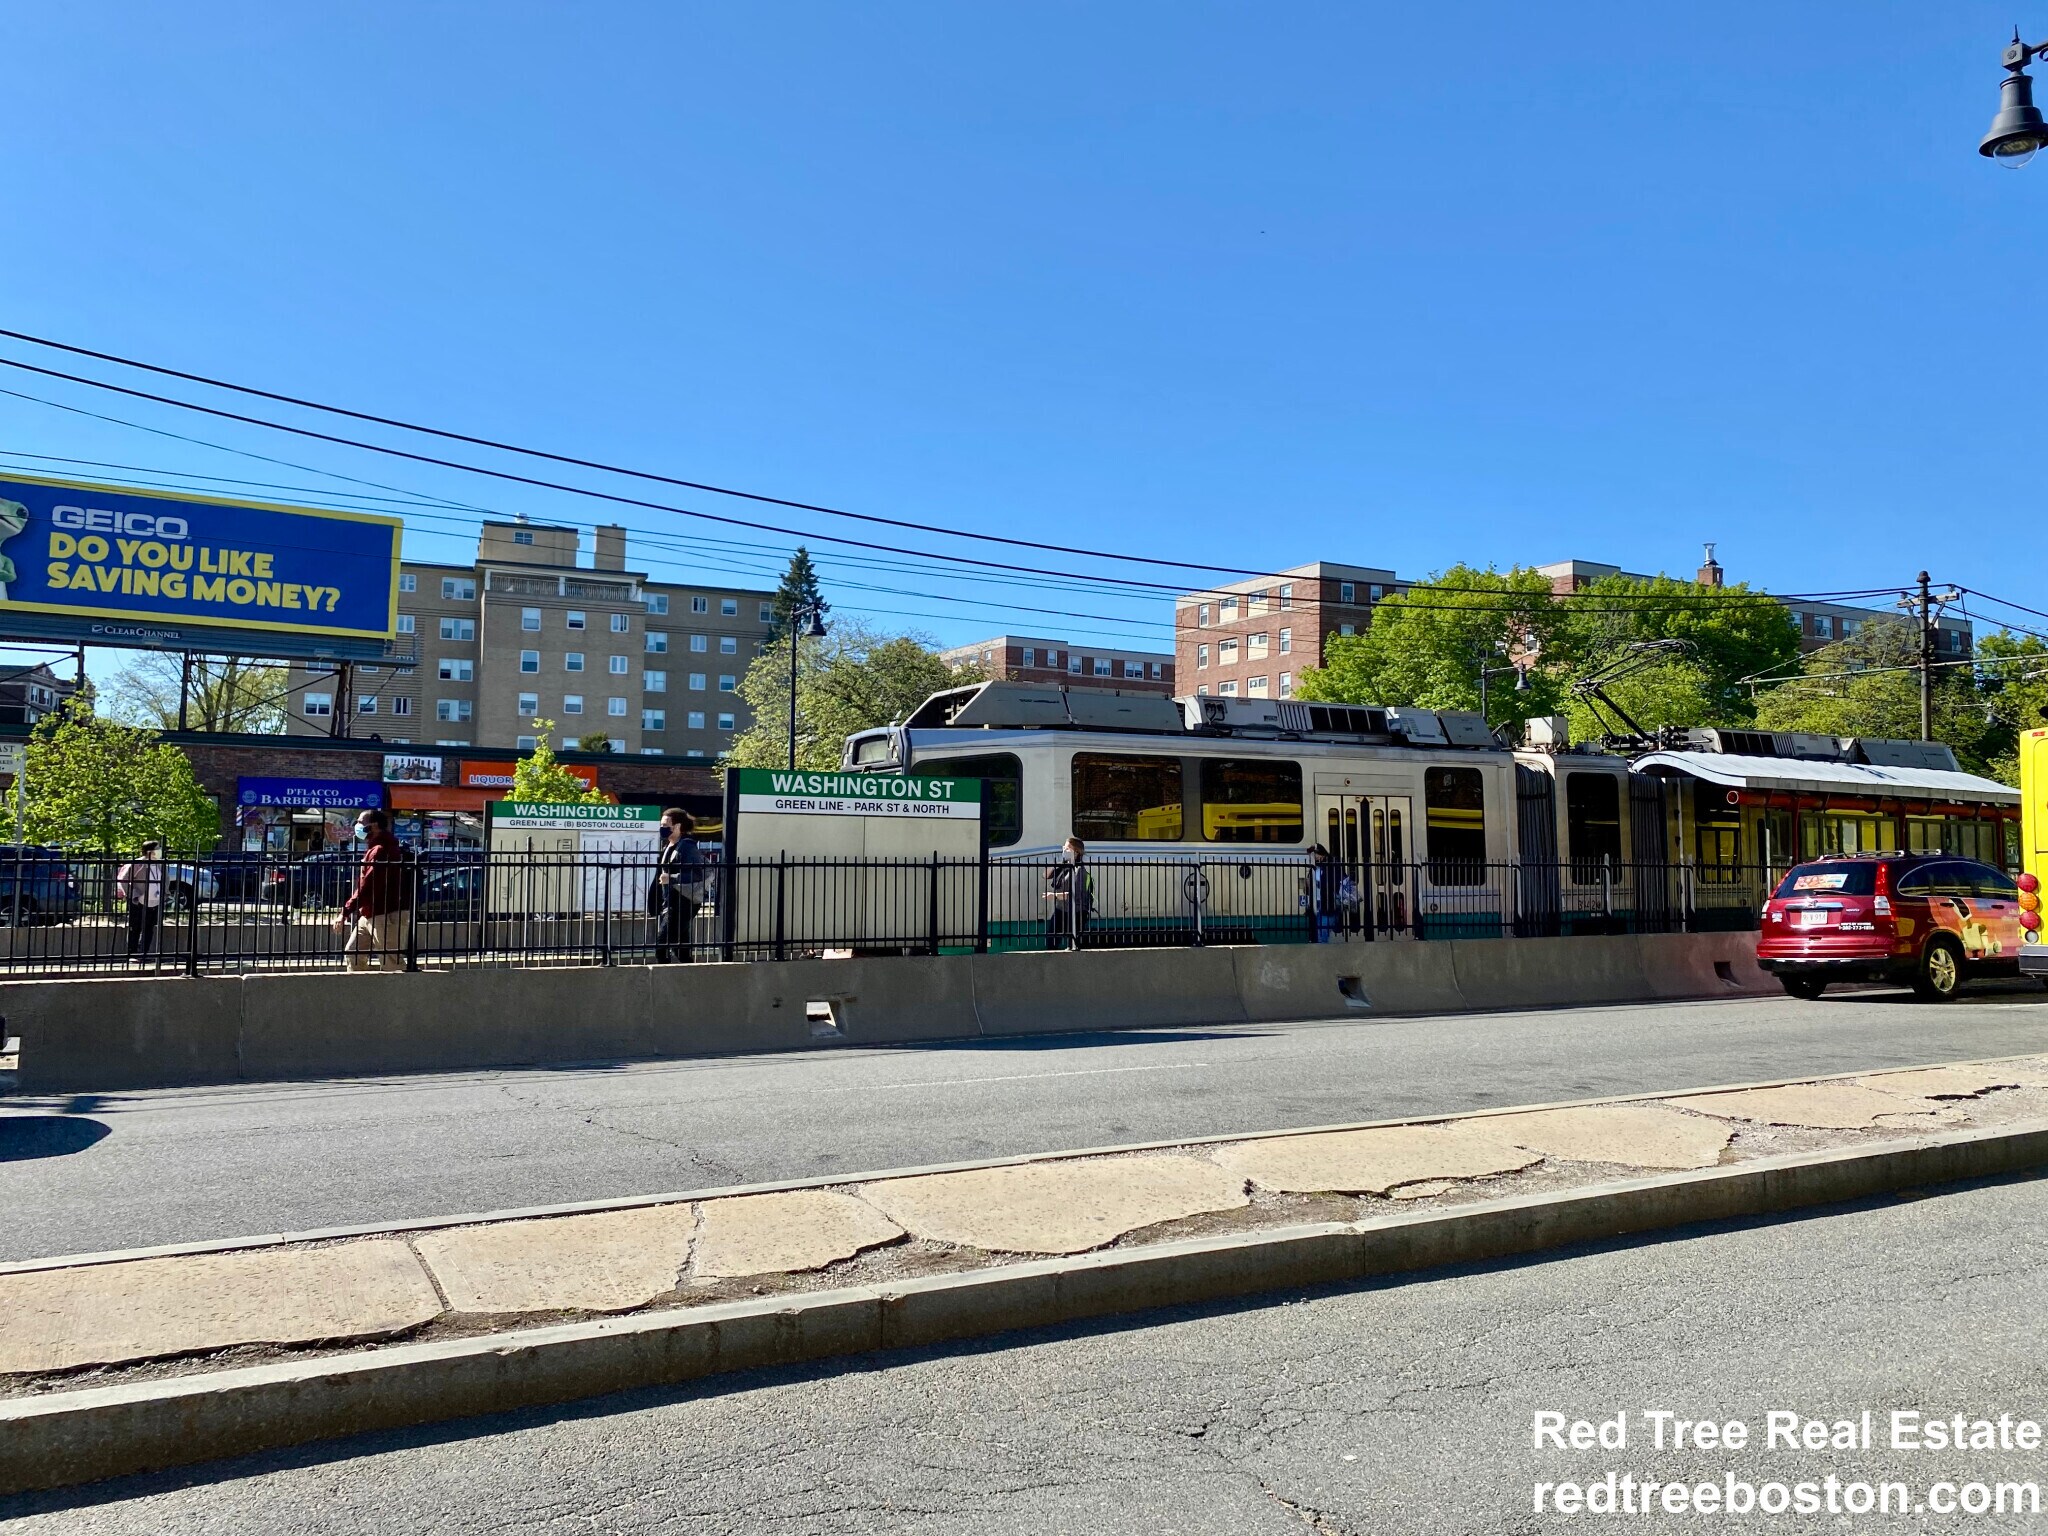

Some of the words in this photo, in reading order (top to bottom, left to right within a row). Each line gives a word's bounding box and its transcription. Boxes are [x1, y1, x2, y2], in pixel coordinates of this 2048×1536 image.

[51, 505, 188, 540] GEICO
[48, 531, 110, 562] DO
[116, 538, 194, 570] YOU
[199, 547, 274, 579] LIKE
[47, 561, 188, 600] SAVING
[192, 575, 341, 613] MONEY?
[469, 774, 515, 786] LIQUOR
[771, 774, 922, 798] WASHINGTON
[928, 780, 954, 799] ST
[286, 788, 340, 797] D'FLACCO
[261, 794, 320, 806] BARBER
[324, 796, 364, 807] SHOP
[775, 799, 815, 810] GREEN
[819, 800, 844, 811] LINE
[854, 802, 883, 812] PARK
[886, 803, 901, 813] ST
[902, 804, 910, 813] &
[913, 804, 950, 814] NORTH
[514, 803, 619, 819] WASHINGTON
[623, 807, 642, 819] ST
[509, 819, 537, 828] GREEN
[539, 820, 557, 828] LINE
[564, 820, 574, 829] (B)
[576, 821, 608, 829] BOSTON
[610, 821, 645, 829] COLLEGE
